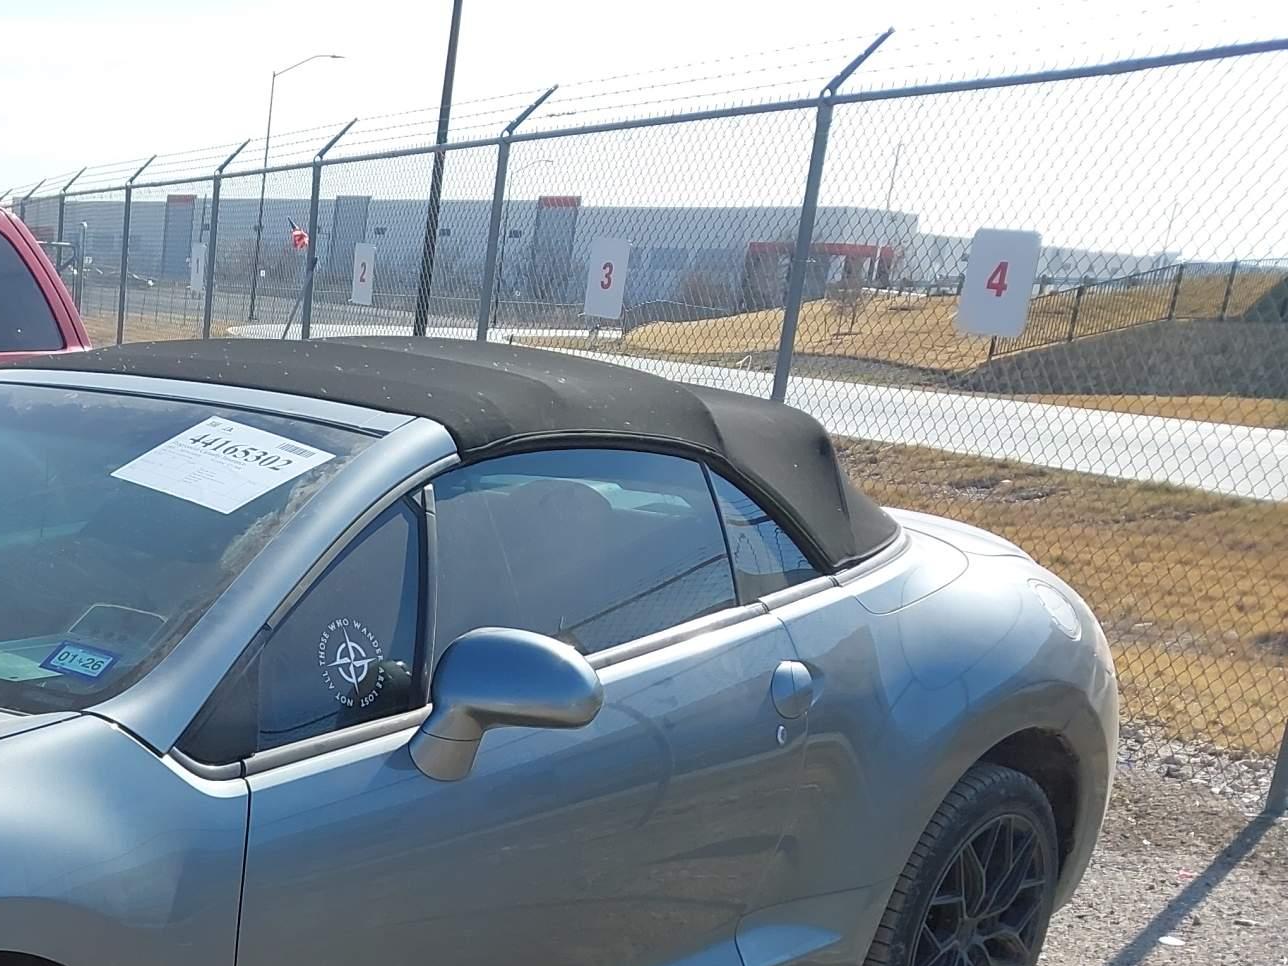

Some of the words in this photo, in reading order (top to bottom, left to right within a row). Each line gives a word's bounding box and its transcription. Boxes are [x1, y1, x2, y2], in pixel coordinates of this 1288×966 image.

[359, 262, 367, 283] 2
[600, 262, 614, 290] 3
[986, 261, 1009, 297] 4
[189, 433, 293, 471] 44165302
[328, 618, 349, 632] WHO
[318, 631, 330, 667] THOSE
[353, 619, 384, 662] WANDER
[322, 670, 336, 689] ALL
[376, 666, 385, 689] ARE
[335, 691, 354, 707] NOT
[360, 690, 379, 708] LOST
